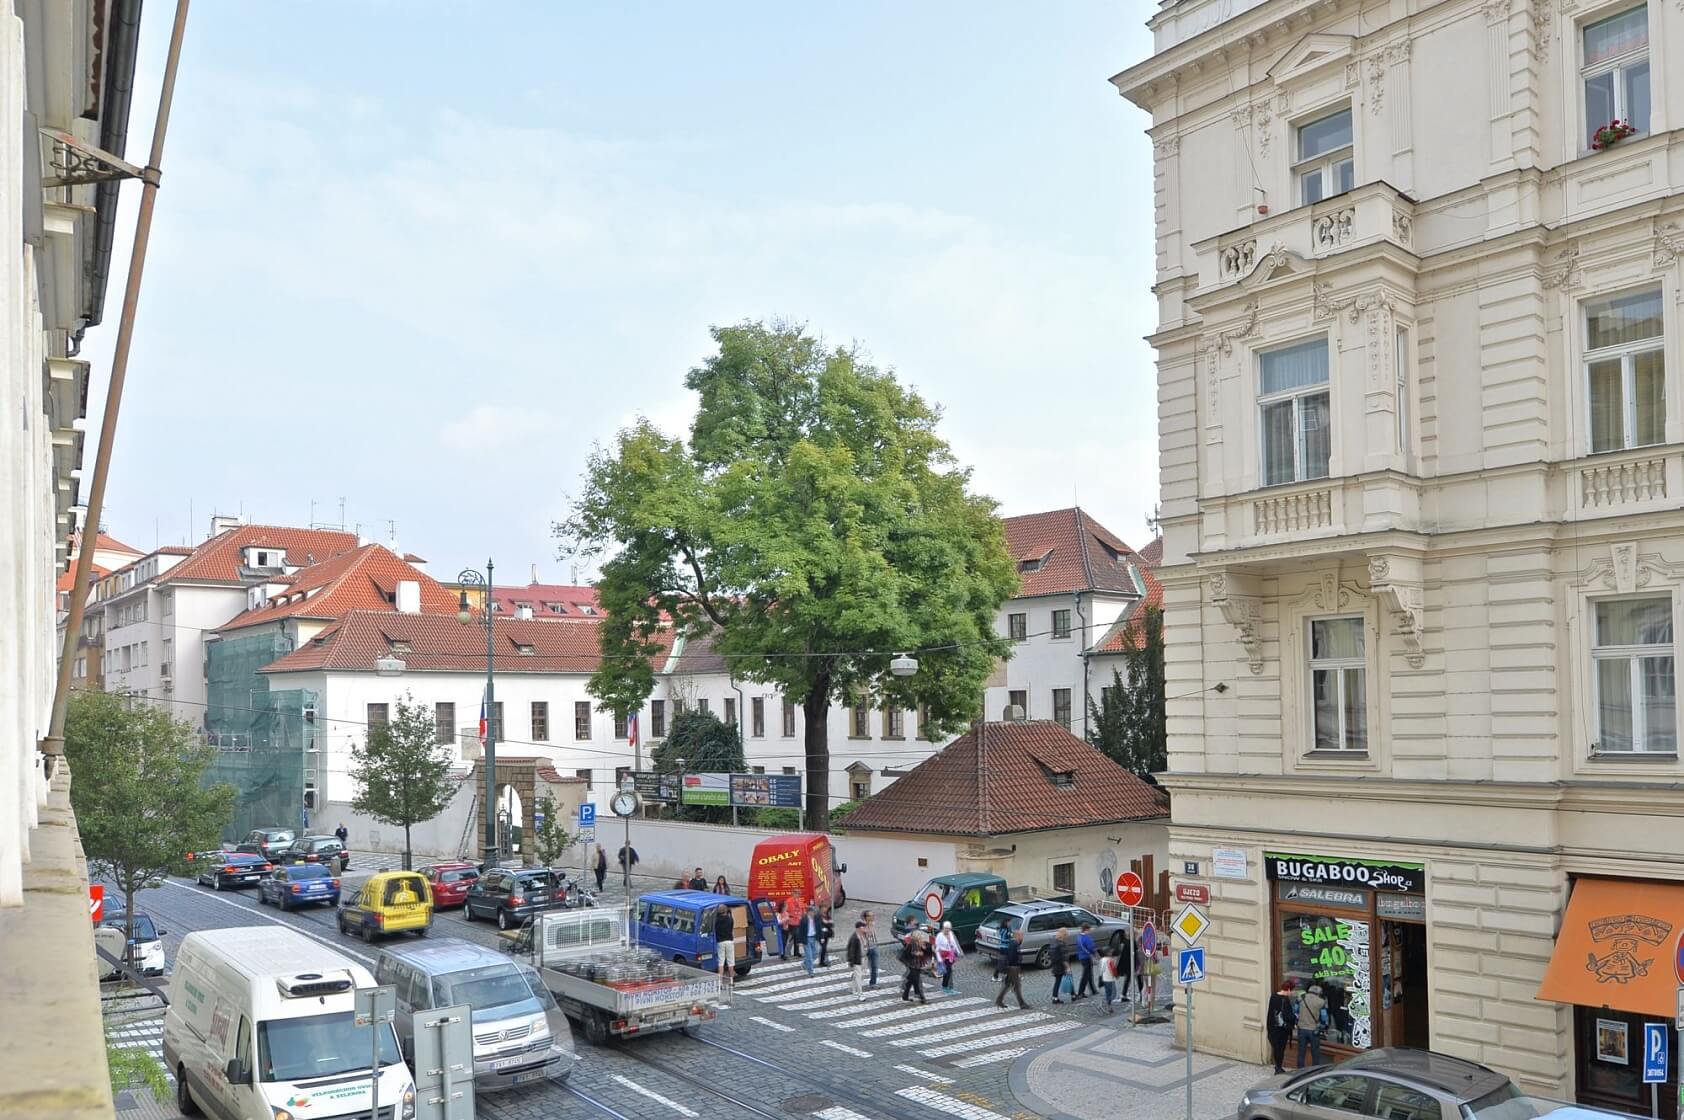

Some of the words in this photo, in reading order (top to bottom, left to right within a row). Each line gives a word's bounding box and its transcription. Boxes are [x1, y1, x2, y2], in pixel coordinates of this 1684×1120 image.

[582, 806, 592, 820] P
[758, 849, 800, 865] OBALY
[1276, 860, 1370, 883] BUGABOO
[1301, 923, 1352, 945] SALE
[1651, 1029, 1661, 1061] P
